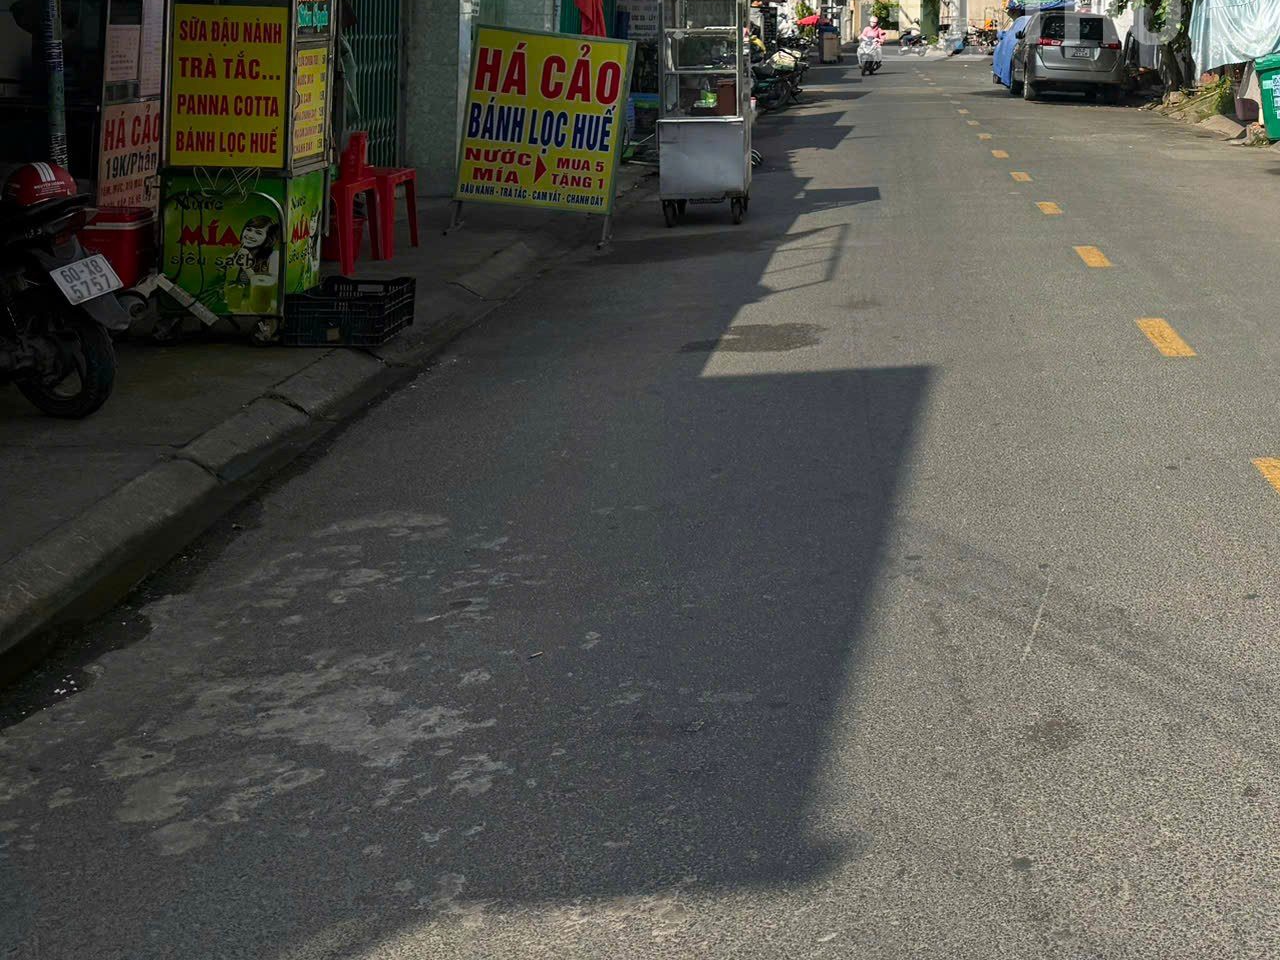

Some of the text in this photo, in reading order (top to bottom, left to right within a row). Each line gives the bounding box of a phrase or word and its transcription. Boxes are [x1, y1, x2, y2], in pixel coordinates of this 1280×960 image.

[180, 16, 282, 46] SỮA ĐẬU NÀNH
[179, 53, 216, 78] TRÀ
[474, 42, 621, 105] HÁ CẢO
[177, 94, 230, 116] PANNA
[234, 95, 279, 117] COTTA
[104, 104, 160, 152] HÁ CẢO
[468, 96, 616, 154] BÁNH LỌC HUẾ
[176, 126, 215, 152] BÁNH
[220, 132, 246, 158] LỌC
[250, 126, 278, 154] HUẾ
[466, 147, 532, 166] NƯỚC
[556, 158, 604, 172] MUA 5
[472, 166, 519, 184] MÍA
[551, 172, 603, 189] TẶNG 1
[532, 190, 547, 201] CAM
[566, 193, 589, 205] CHANH
[176, 220, 241, 246] MÍA
[60, 260, 103, 284] 60-X8
[70, 273, 112, 298] 5757
